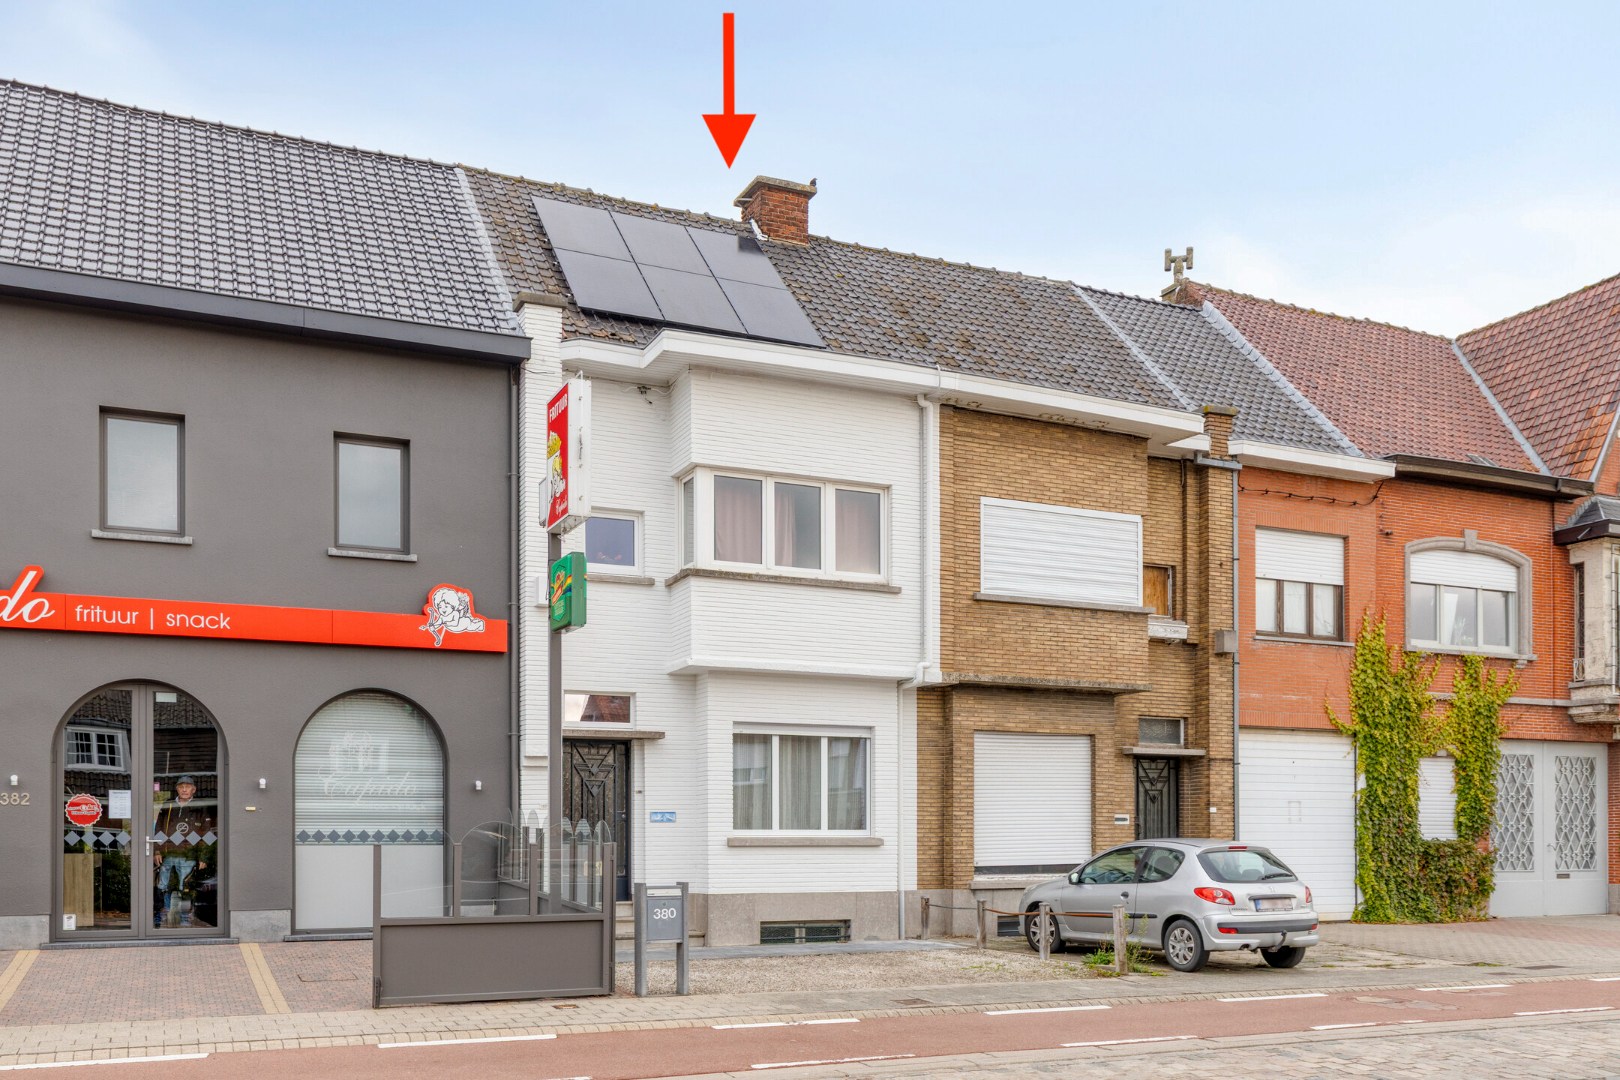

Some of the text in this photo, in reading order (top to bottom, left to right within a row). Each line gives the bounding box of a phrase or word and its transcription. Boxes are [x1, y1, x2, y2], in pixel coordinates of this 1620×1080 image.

[549, 393, 567, 423] FRITUUR
[75, 604, 231, 630] frituur snack
[0, 792, 30, 806] 382
[653, 907, 677, 920] 380
